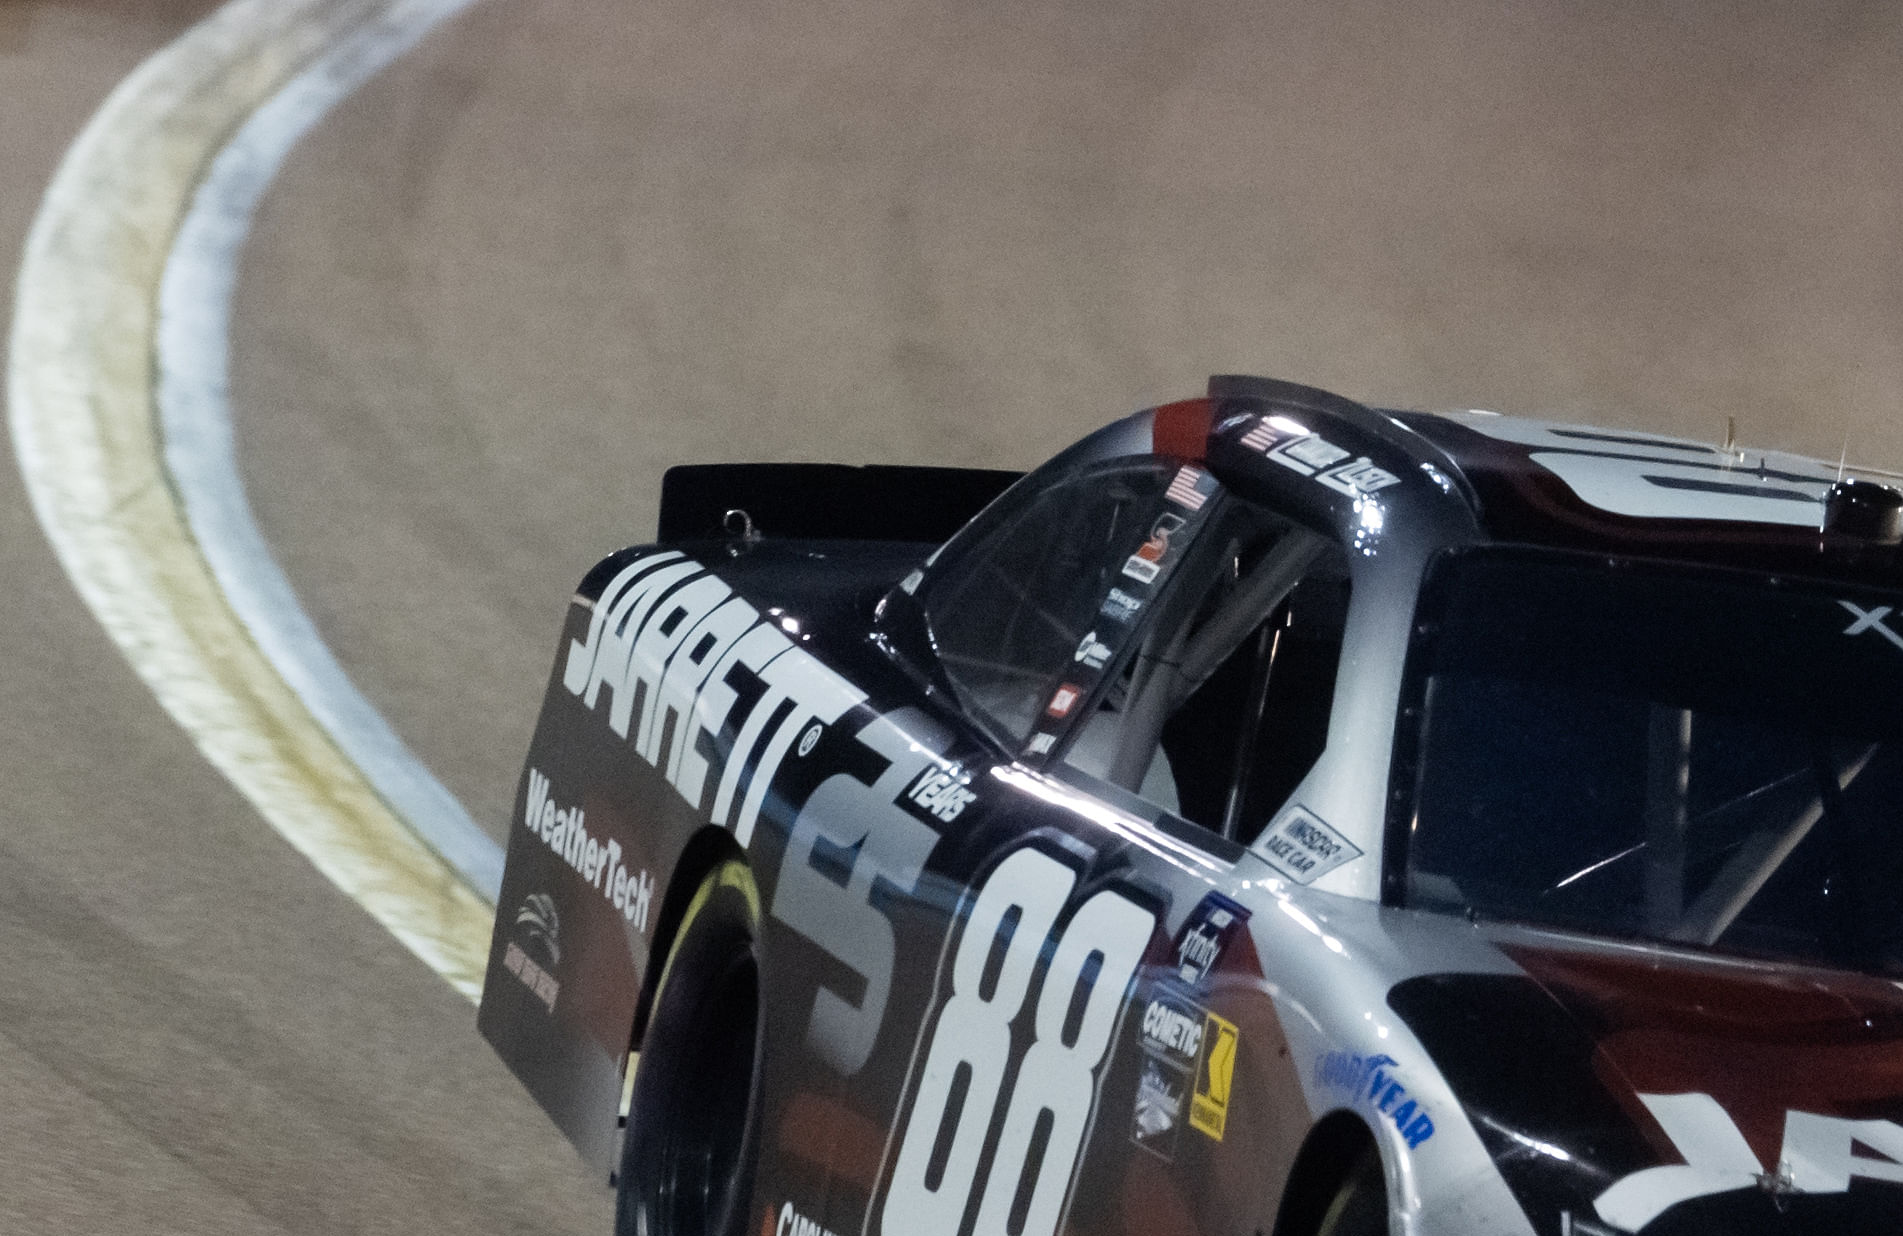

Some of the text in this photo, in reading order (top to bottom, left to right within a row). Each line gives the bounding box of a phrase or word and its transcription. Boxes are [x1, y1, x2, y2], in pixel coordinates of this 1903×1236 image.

[563, 551, 869, 848] JARRETT
[908, 767, 977, 822] YEARS
[525, 767, 652, 932] WeatherTech
[1287, 852, 1316, 873] CAR
[1178, 923, 1221, 979] xfinity
[1143, 1000, 1202, 1058] COMETIC
